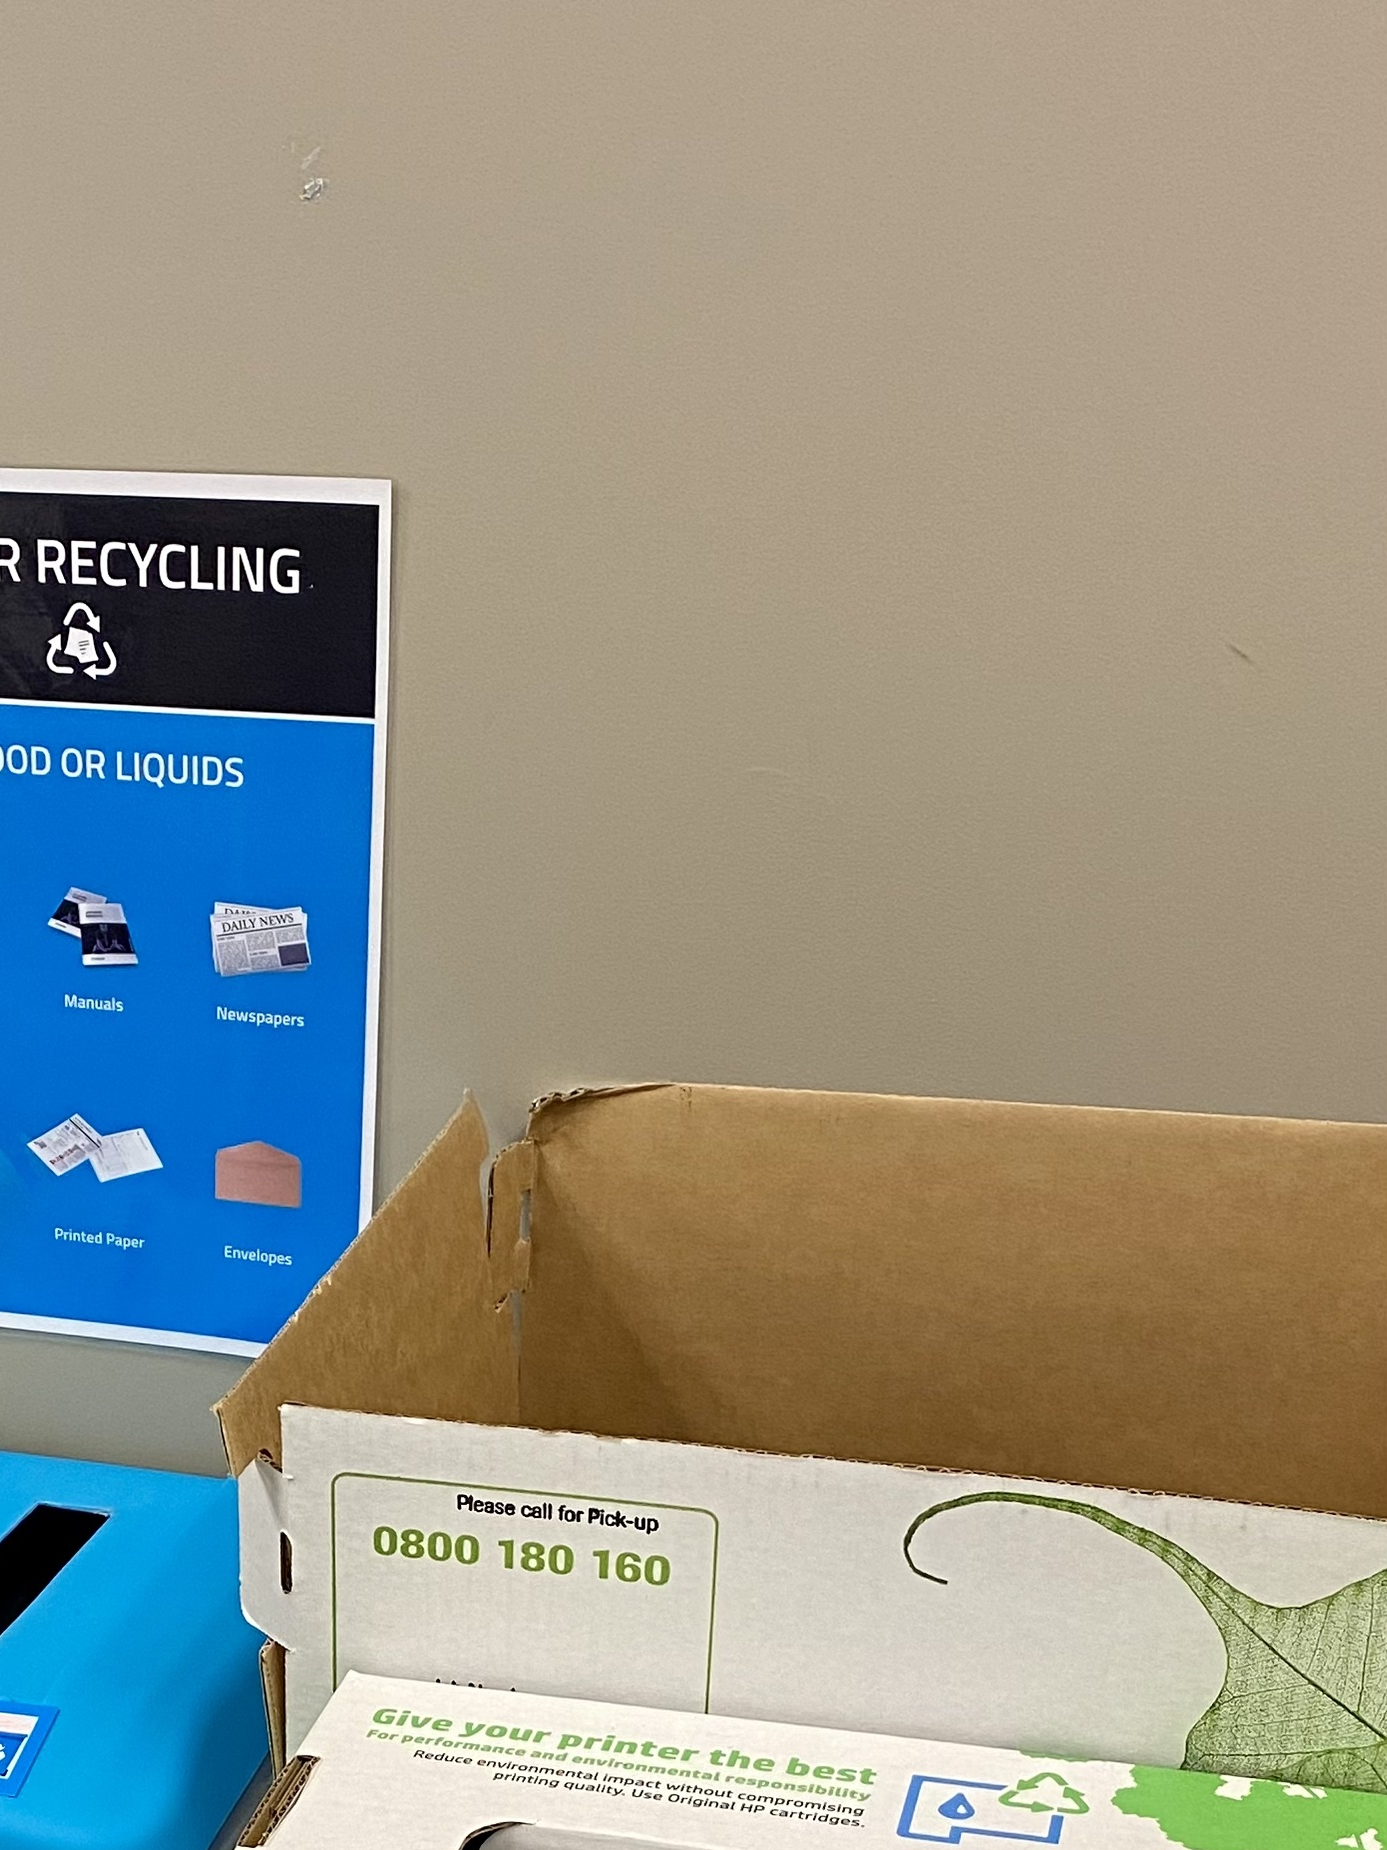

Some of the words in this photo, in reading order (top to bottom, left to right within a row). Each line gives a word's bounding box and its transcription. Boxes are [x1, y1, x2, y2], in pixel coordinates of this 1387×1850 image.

[37, 539, 300, 594] RECYCLING
[61, 748, 105, 779] OR
[117, 751, 244, 788] LIQUIDS
[222, 918, 256, 932] DAILY
[259, 913, 294, 926] NEWS
[64, 994, 124, 1012] Manuals
[217, 1006, 304, 1028] Newspapers
[55, 1228, 102, 1244] Printed
[106, 1233, 145, 1250] Paper
[224, 1245, 292, 1266] Envelopes
[457, 1494, 516, 1516] Please
[521, 1502, 553, 1520] call
[558, 1505, 585, 1523] for
[588, 1508, 659, 1535] Pick-up
[373, 1526, 480, 1565] 0800
[498, 1539, 574, 1575] 180
[592, 1550, 670, 1586] 160
[366, 1729, 399, 1740] For
[401, 1735, 527, 1756] performance
[530, 1751, 568, 1762] and
[571, 1756, 720, 1781] environmental
[725, 1776, 871, 1799] responsibility
[372, 1708, 453, 1732] Give
[458, 1722, 552, 1743] your
[557, 1734, 700, 1762] printer
[709, 1750, 775, 1772] the
[785, 1757, 877, 1785] best
[413, 1750, 473, 1764] Reduce
[477, 1760, 599, 1781] environmental
[603, 1773, 662, 1789] impact
[666, 1783, 733, 1798] without
[738, 1793, 865, 1817] compromising
[492, 1773, 560, 1788] printing
[564, 1782, 625, 1796] quality.
[632, 1789, 663, 1801] Use
[668, 1794, 736, 1810] Original
[740, 1803, 765, 1813] HP
[769, 1809, 865, 1828] cartridges.
